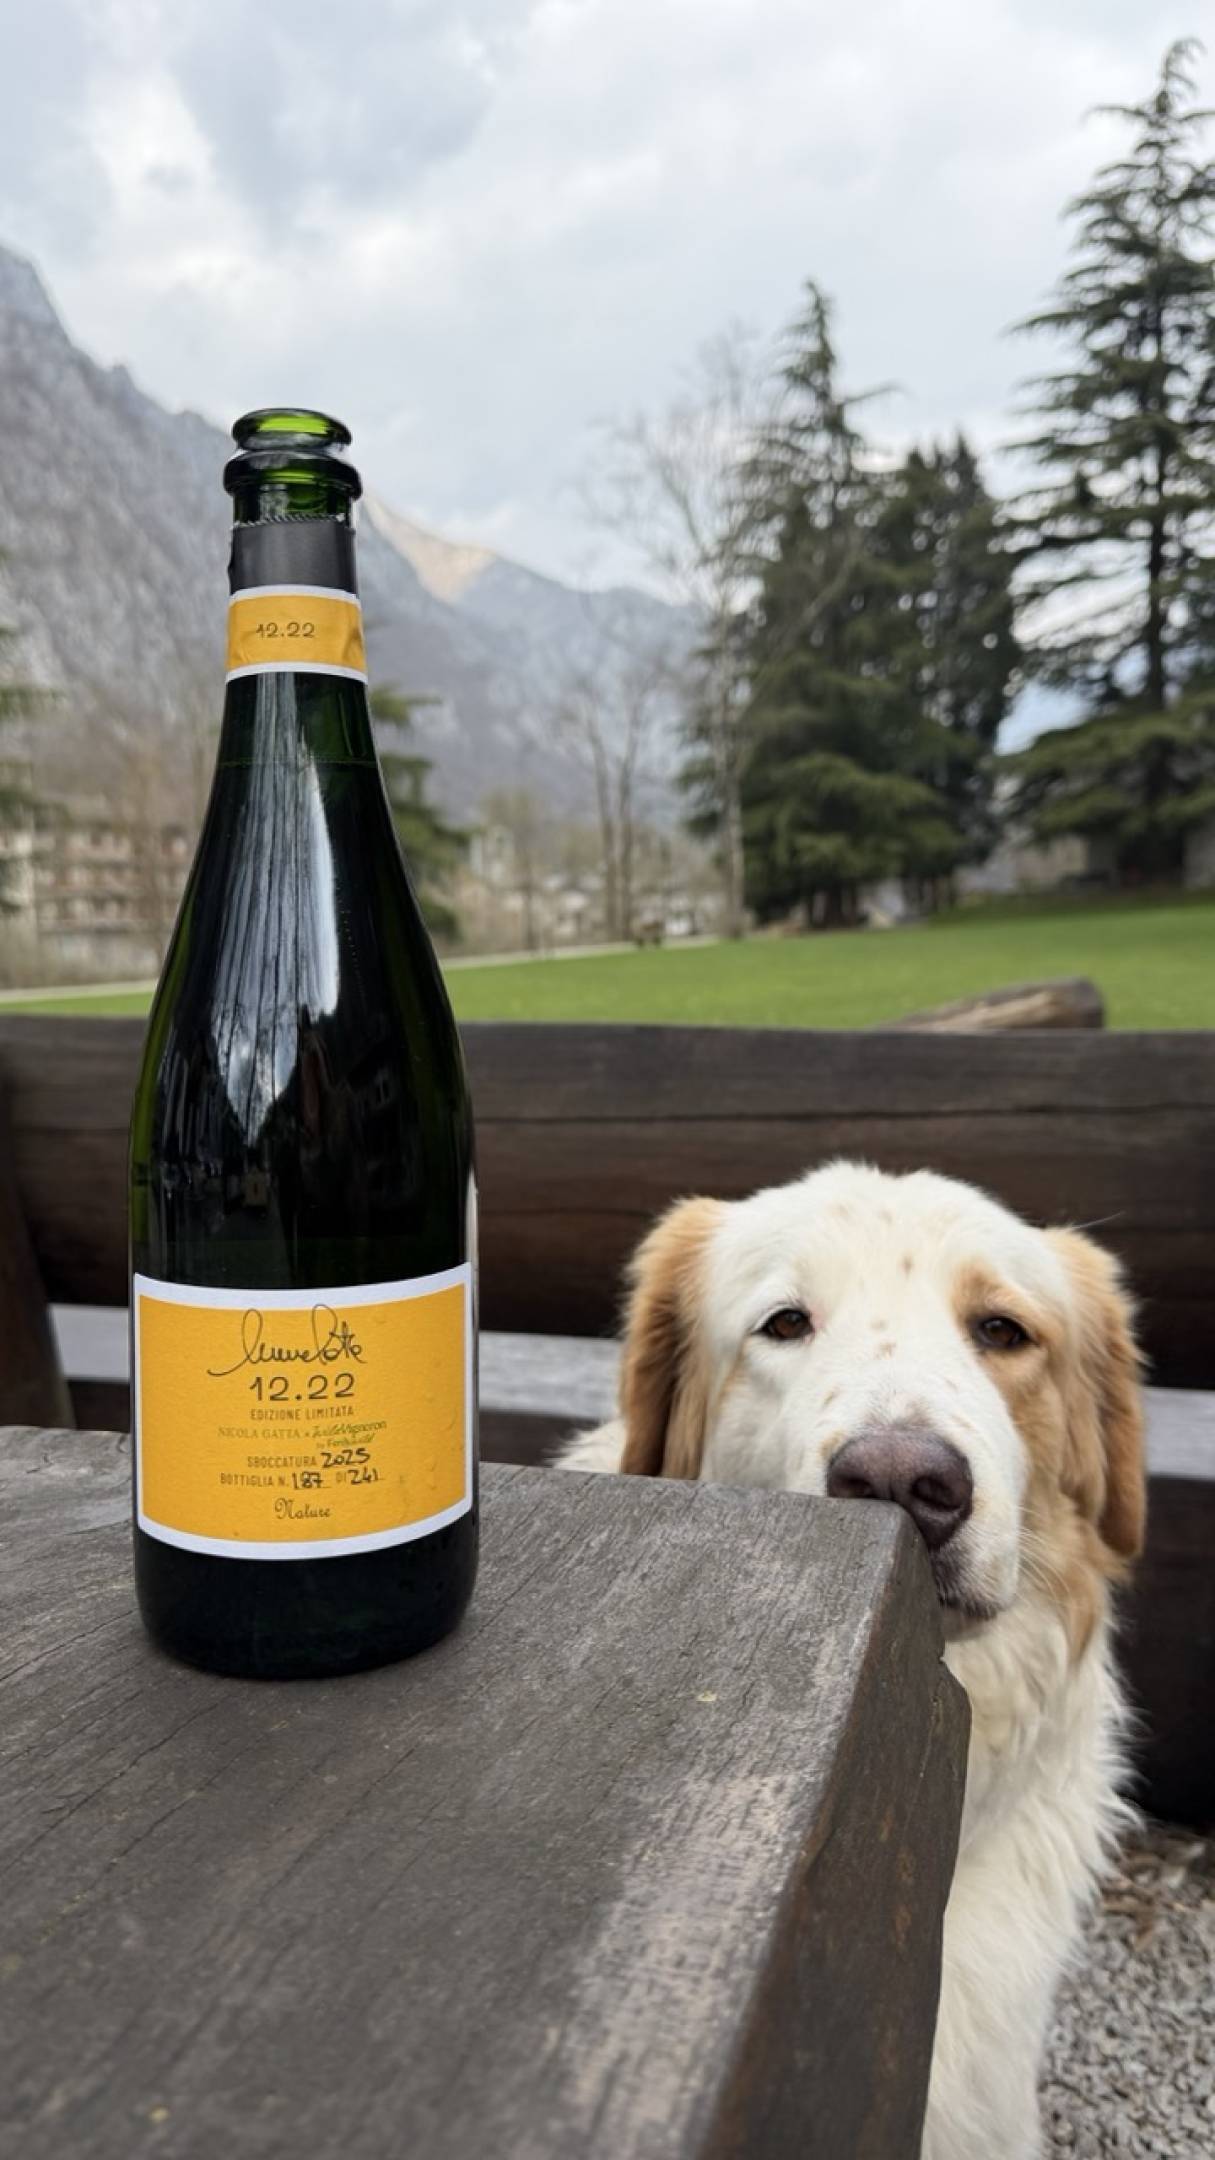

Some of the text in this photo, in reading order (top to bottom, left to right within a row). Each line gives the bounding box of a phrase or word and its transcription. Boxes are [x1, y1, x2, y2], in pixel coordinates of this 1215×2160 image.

[256, 622, 315, 639] 12.22
[249, 1372, 355, 1401] 12.22
[251, 1405, 355, 1421] EDIZIONE LIMITATA
[247, 1448, 371, 1469] SBOCCATURA 2025
[220, 1472, 274, 1487] BOTTIGLIA
[274, 1497, 331, 1520] Nature
